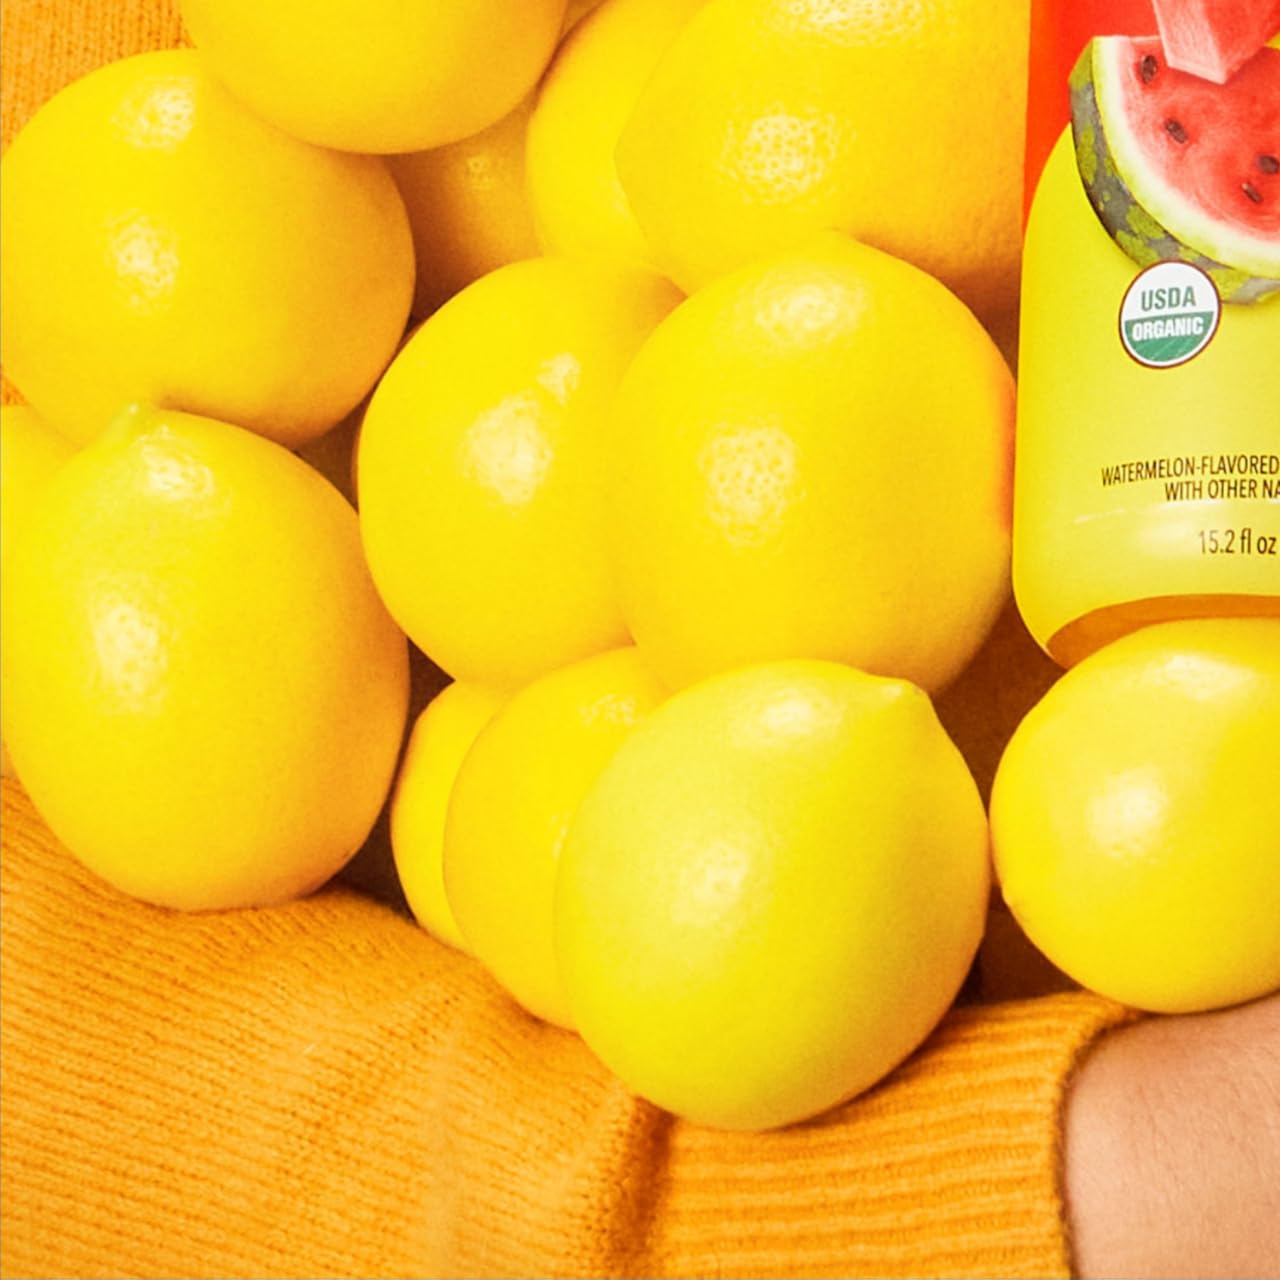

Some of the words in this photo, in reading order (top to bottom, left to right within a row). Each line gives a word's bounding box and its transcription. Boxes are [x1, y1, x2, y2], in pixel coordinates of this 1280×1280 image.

[1141, 286, 1197, 312] USDA
[1132, 316, 1204, 342] ORGANIC
[1101, 454, 1280, 487] WATERMELON-FLAVORED
[1164, 481, 1202, 502] WITH
[1207, 479, 1258, 500] OTHER
[1199, 529, 1236, 555] 15.2
[1240, 527, 1252, 555] fl
[1256, 536, 1277, 555] oz
